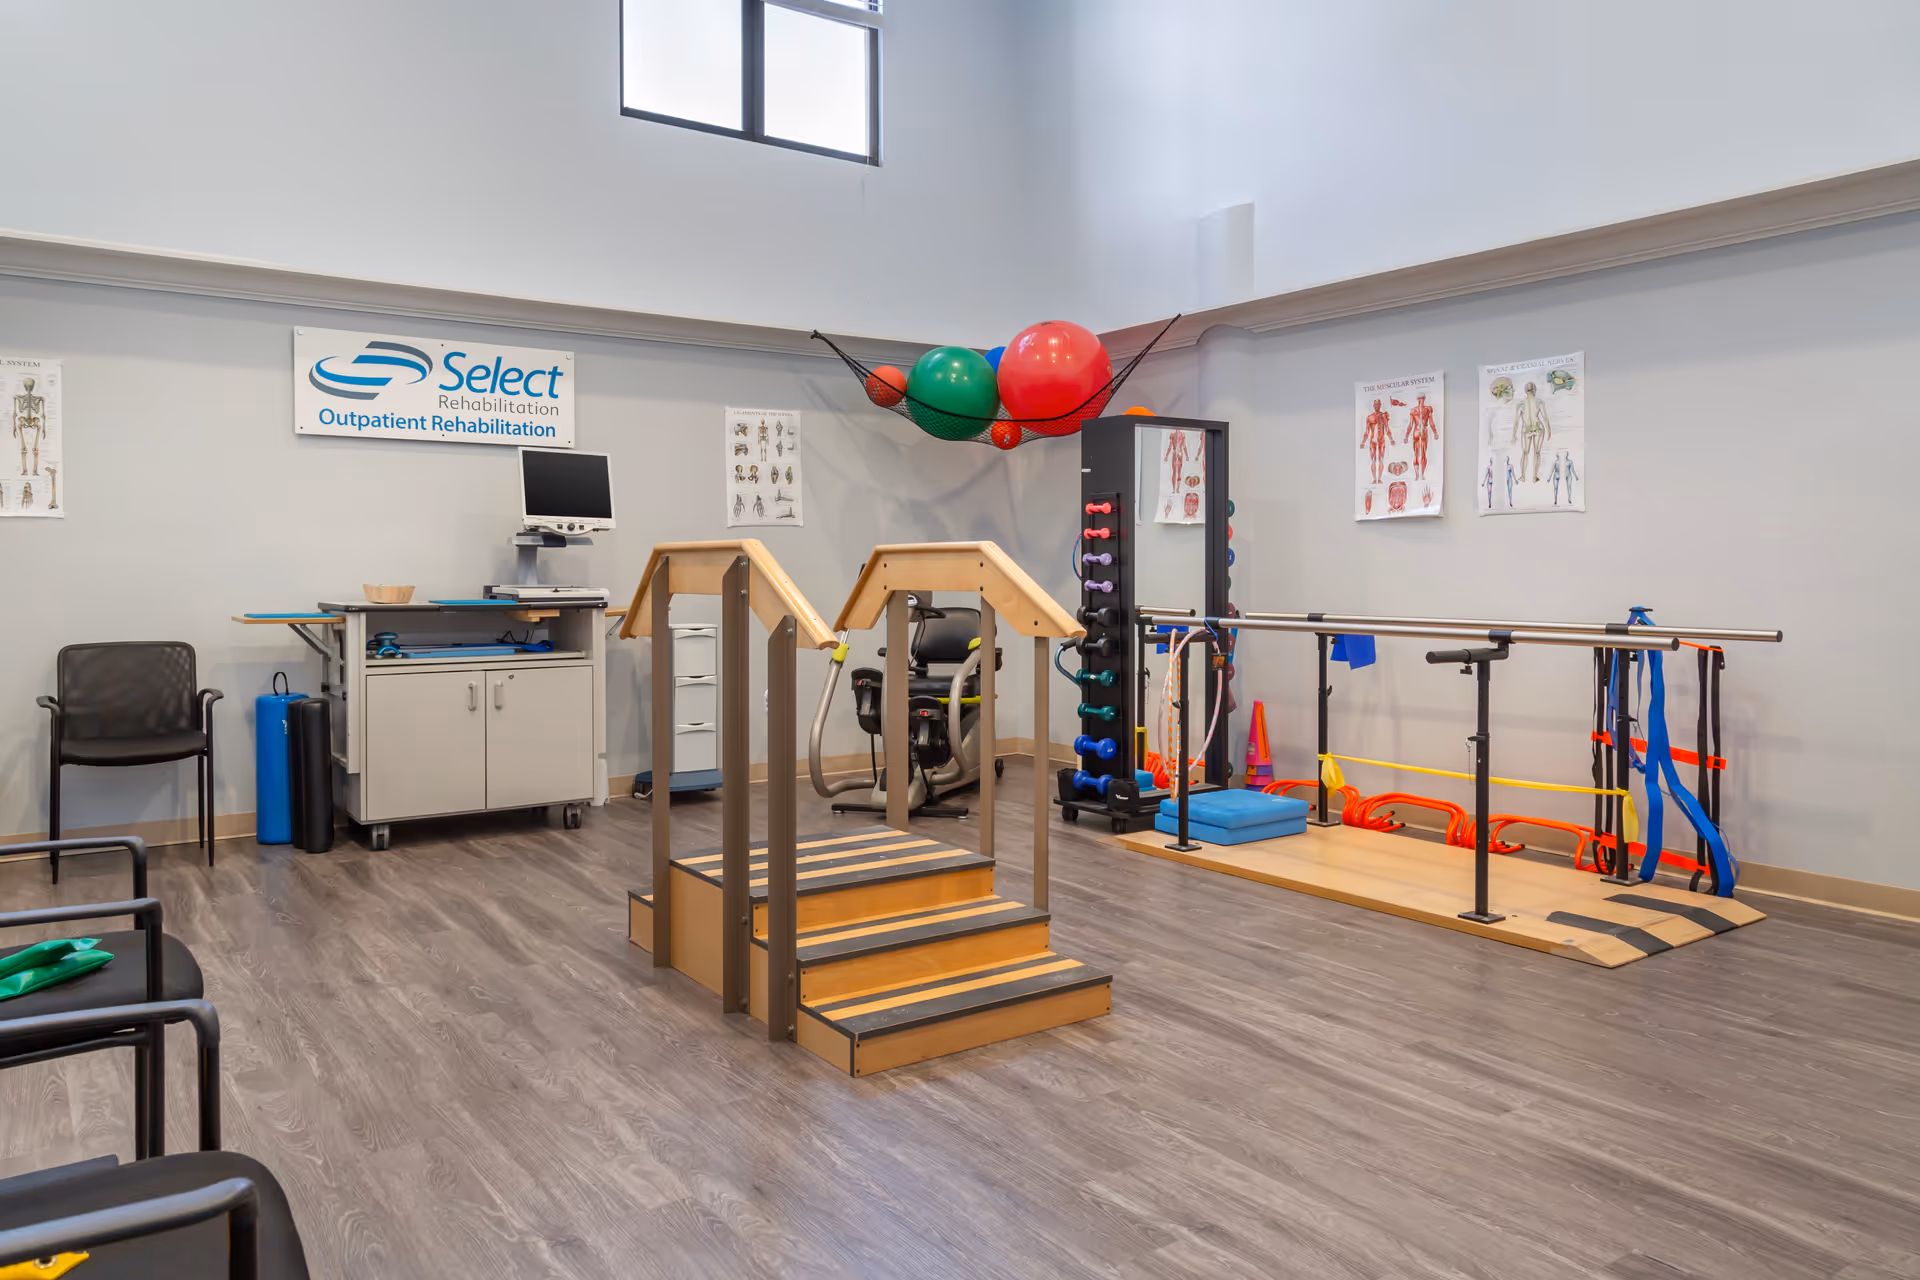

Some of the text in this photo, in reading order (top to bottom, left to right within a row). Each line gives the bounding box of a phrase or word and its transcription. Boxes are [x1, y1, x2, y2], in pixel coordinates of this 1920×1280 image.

[6, 360, 41, 368] SYSTEM
[438, 351, 564, 399] Select
[1363, 376, 1435, 393] THE MUSCULAR SYSTEM
[438, 394, 560, 416] Rehabilitation
[318, 407, 556, 438] Outpatient Rehabilitation
